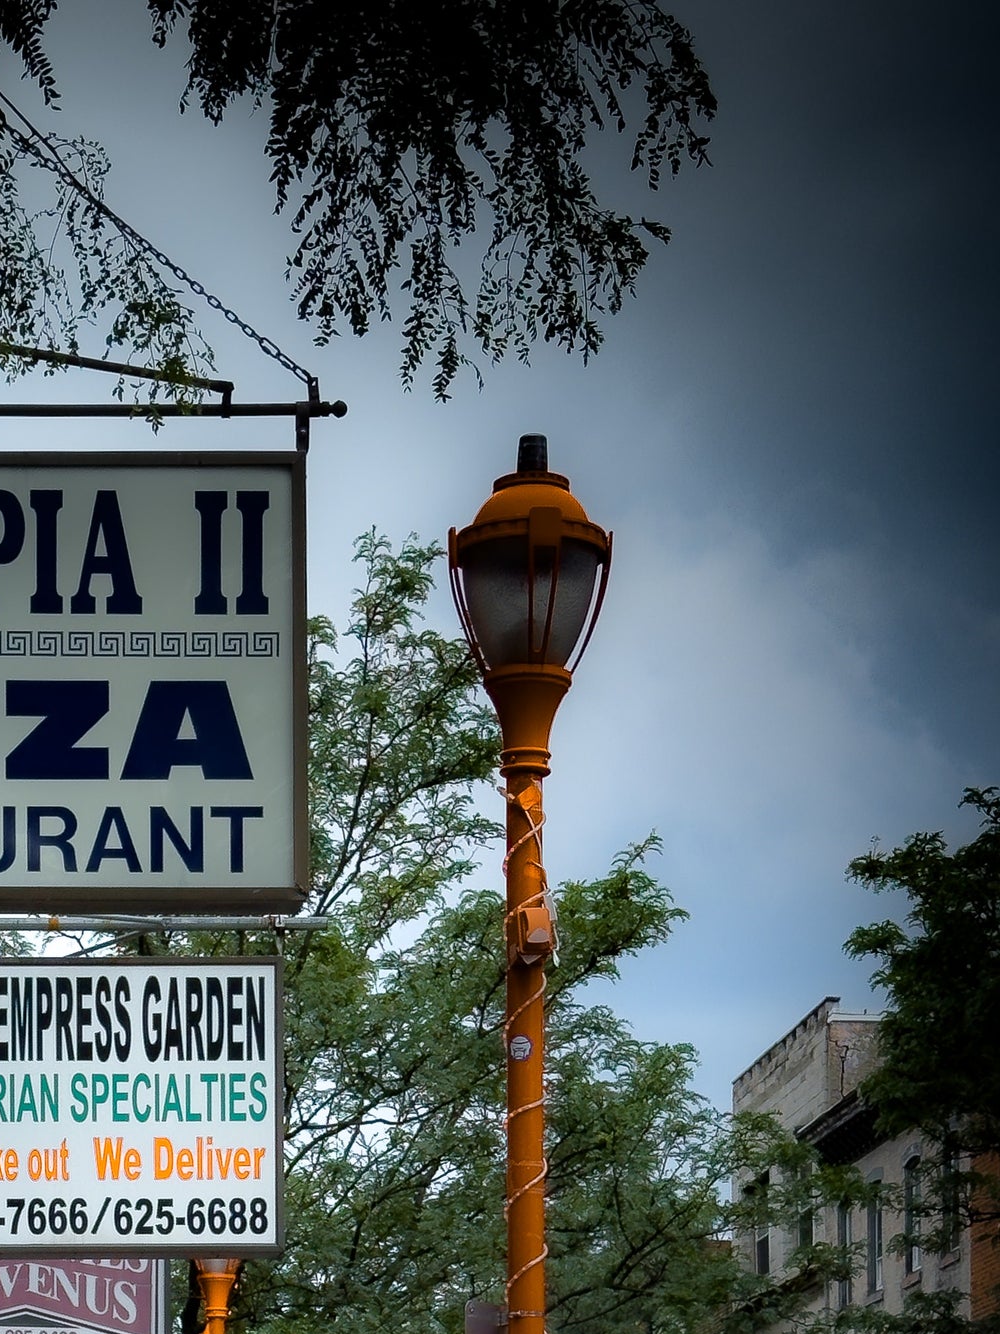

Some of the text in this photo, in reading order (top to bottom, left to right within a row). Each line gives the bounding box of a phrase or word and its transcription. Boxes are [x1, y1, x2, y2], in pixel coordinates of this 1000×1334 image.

[194, 490, 270, 615] II
[142, 975, 267, 1062] GARDEN
[69, 1072, 268, 1123] SPECIALTIES
[27, 1138, 70, 1181] out
[93, 1137, 143, 1181] We
[153, 1136, 267, 1181] Deliver
